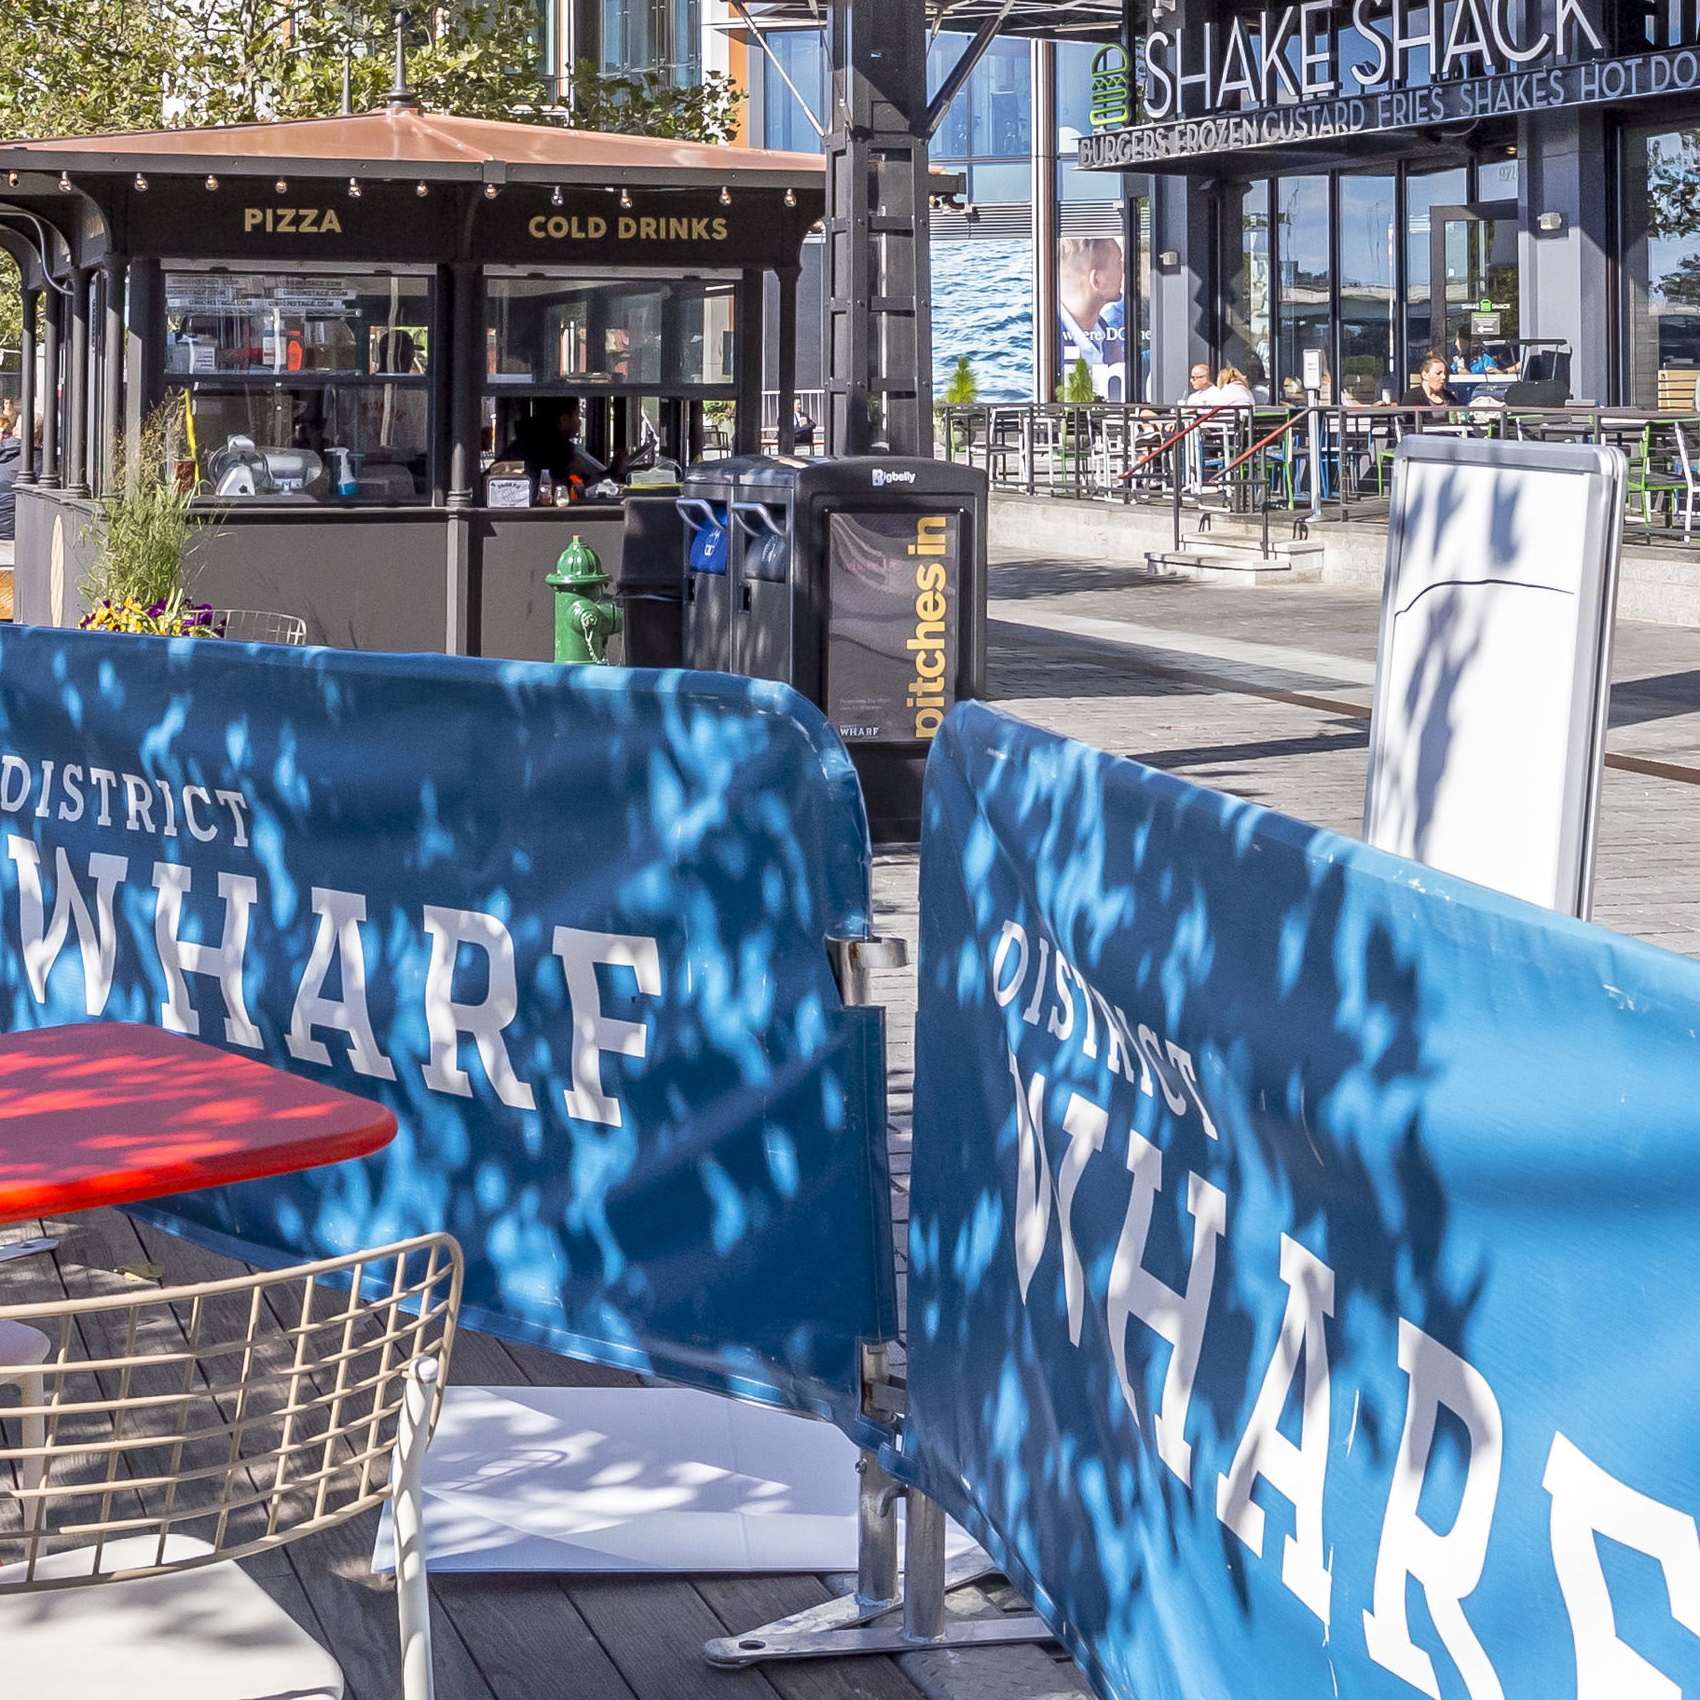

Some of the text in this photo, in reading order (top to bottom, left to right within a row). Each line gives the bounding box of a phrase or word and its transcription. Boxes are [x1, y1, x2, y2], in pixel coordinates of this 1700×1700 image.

[1080, 127, 1165, 167] BURGERS
[1175, 119, 1257, 152] FROZEN
[1262, 100, 1366, 143] CUSTARD
[1379, 89, 1444, 127] FRIES
[1459, 69, 1565, 117] SHAKES
[1581, 58, 1643, 101] HOT
[244, 208, 342, 234] PIZZA
[528, 215, 728, 241] COLD DRINKS
[872, 468, 916, 487] Bigbelly
[906, 516, 947, 738] pitches in
[840, 727, 879, 737] WHARF
[0, 754, 248, 847] DISTRICT
[7, 833, 662, 1128] WHARF
[992, 919, 1219, 1141] DISTRICT
